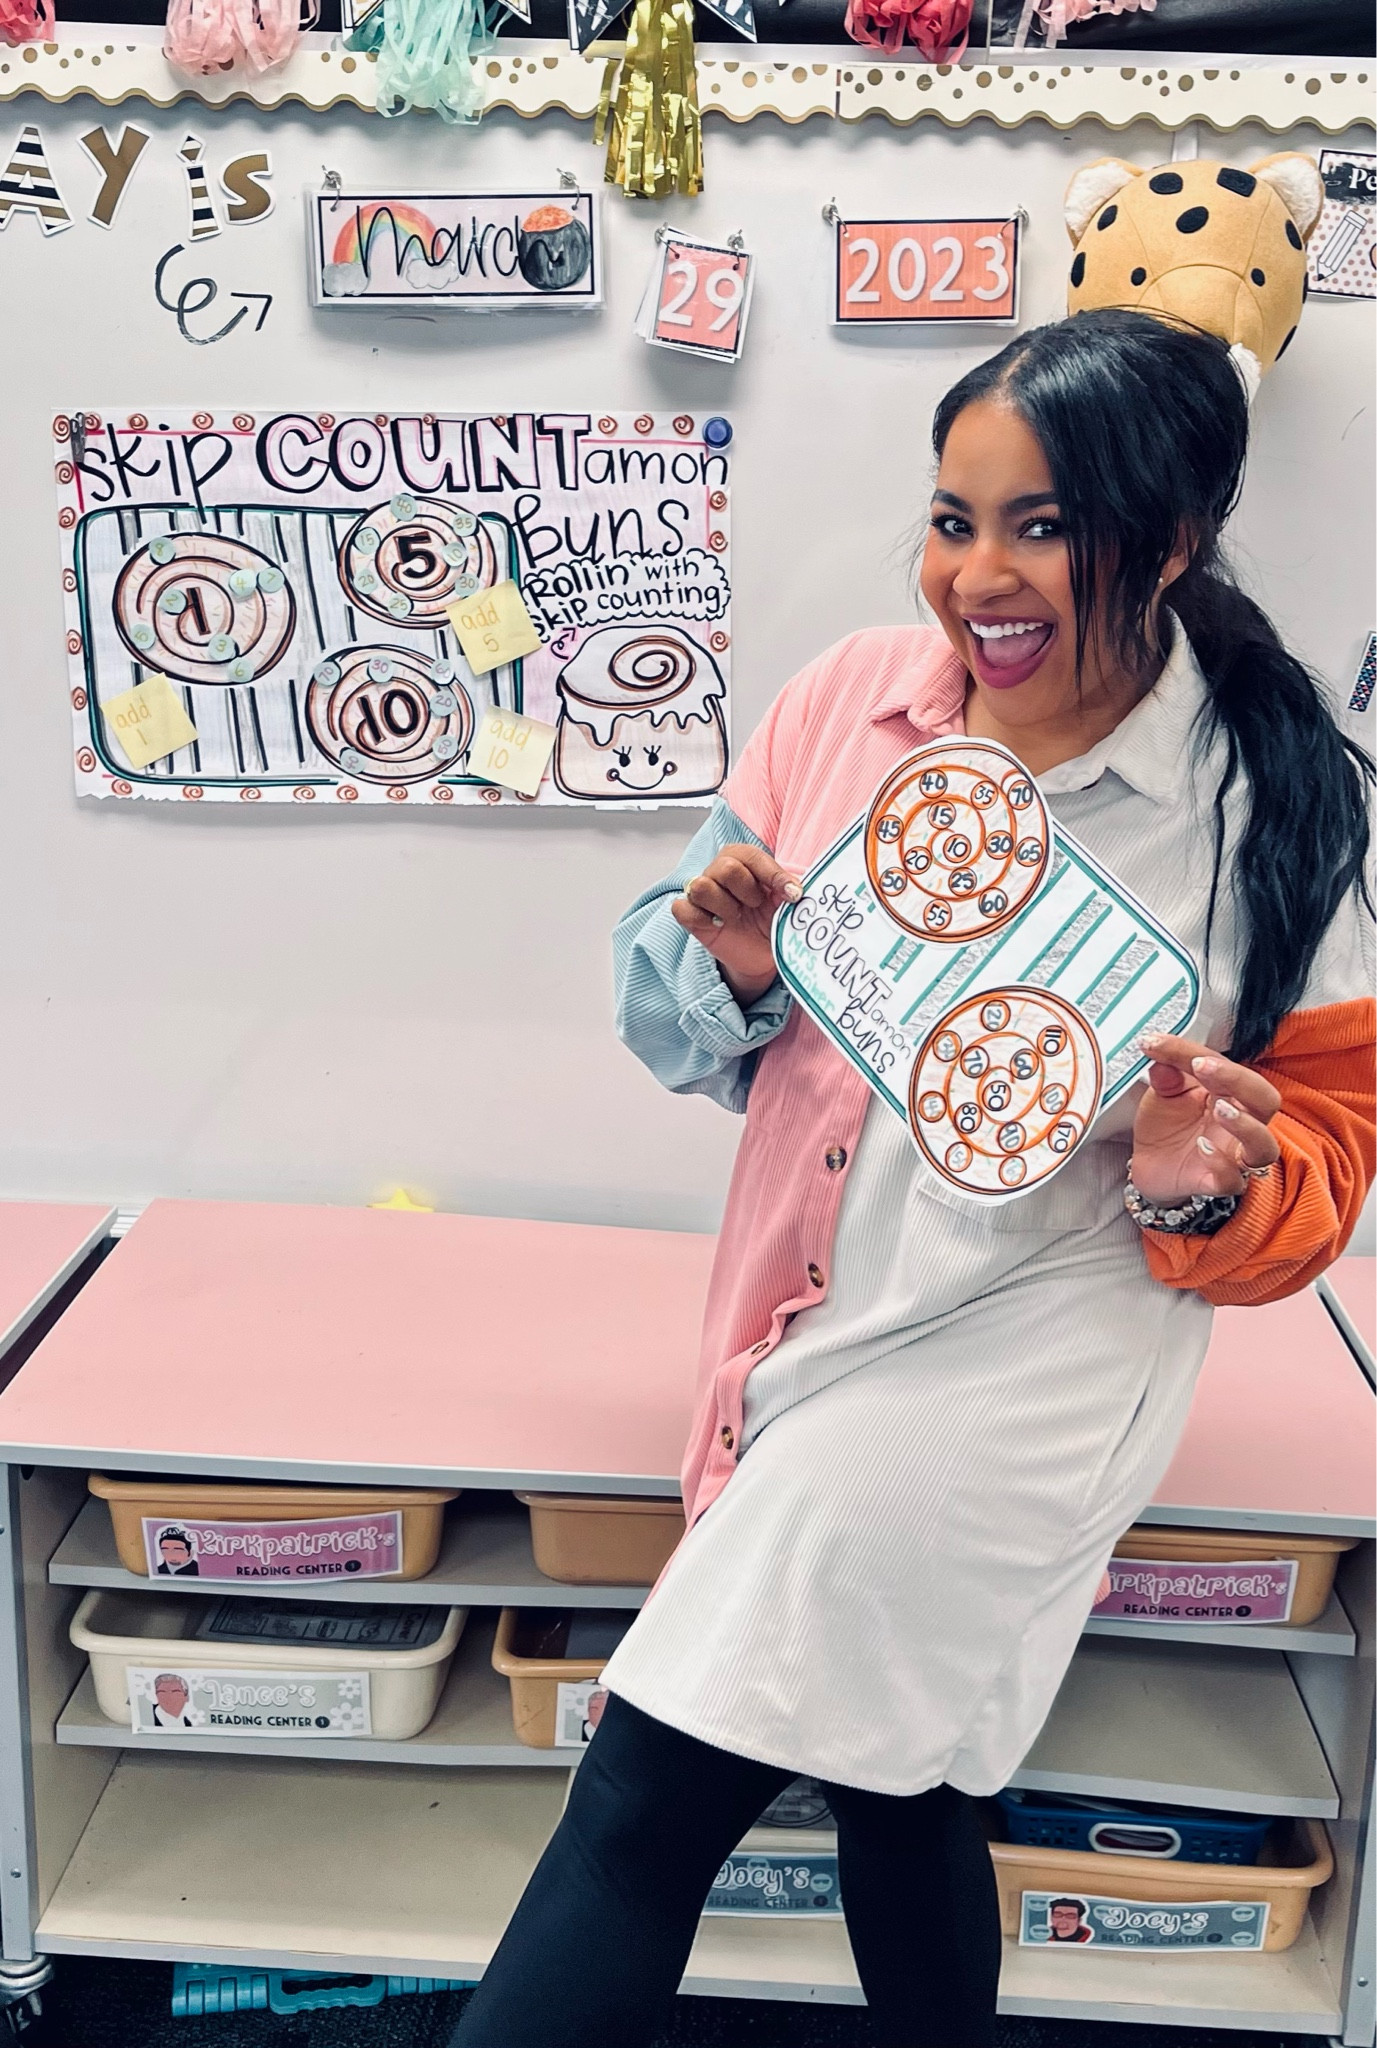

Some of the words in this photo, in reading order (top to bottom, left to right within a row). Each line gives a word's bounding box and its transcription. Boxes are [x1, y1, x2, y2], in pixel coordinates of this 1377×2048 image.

[177, 132, 275, 240] is
[356, 204, 561, 278] March
[845, 236, 1009, 303] 2023
[658, 259, 744, 332] 29
[396, 500, 413, 515] 40
[456, 517, 472, 530] 35
[359, 534, 375, 548] 15
[393, 531, 436, 578] 5
[448, 548, 464, 562] 10
[645, 558, 699, 581] with
[235, 575, 247, 592] 4
[358, 574, 375, 588] 20
[459, 577, 476, 591] 30
[165, 594, 179, 607] 2
[390, 598, 409, 611] 25
[597, 582, 720, 613] counting
[461, 602, 500, 631] add
[214, 639, 227, 653] 3
[482, 632, 500, 653] 5
[233, 665, 246, 678] 6
[317, 666, 335, 682] 70
[372, 661, 389, 674] 30
[116, 694, 152, 728] add
[436, 696, 453, 708] 20
[356, 688, 421, 746] 10
[490, 720, 532, 750] add
[486, 748, 510, 770] 10
[921, 773, 947, 791] 40
[974, 784, 995, 805] 35
[1011, 786, 1033, 806] 70
[932, 805, 952, 825] 15
[878, 820, 901, 839] 45
[948, 837, 968, 858] 10
[989, 836, 1013, 854] 30
[1017, 844, 1042, 864] 65
[906, 850, 930, 871] 20
[882, 870, 906, 891] 50
[951, 871, 974, 890] 25
[981, 893, 1007, 914] 60
[926, 905, 949, 926] 55
[1043, 1028, 1062, 1054] 110
[963, 1049, 985, 1078] 70
[986, 1083, 1007, 1112] 50
[960, 1104, 978, 1133] 80
[1001, 1124, 1021, 1151] 90
[1053, 1122, 1072, 1153] 170
[187, 1526, 396, 1566] Kirkpatrick's
[236, 1564, 290, 1577] READING
[296, 1563, 342, 1576] CENTER
[1109, 1572, 1288, 1605] irkpatrick's
[1123, 1604, 1179, 1616] READING
[1185, 1606, 1233, 1617] CENTER
[203, 1679, 317, 1712] Lance's
[210, 1714, 262, 1726] READING
[267, 1716, 312, 1727] CENTER
[712, 1860, 811, 1897] Joey's
[1102, 1906, 1209, 1935] Joey's
